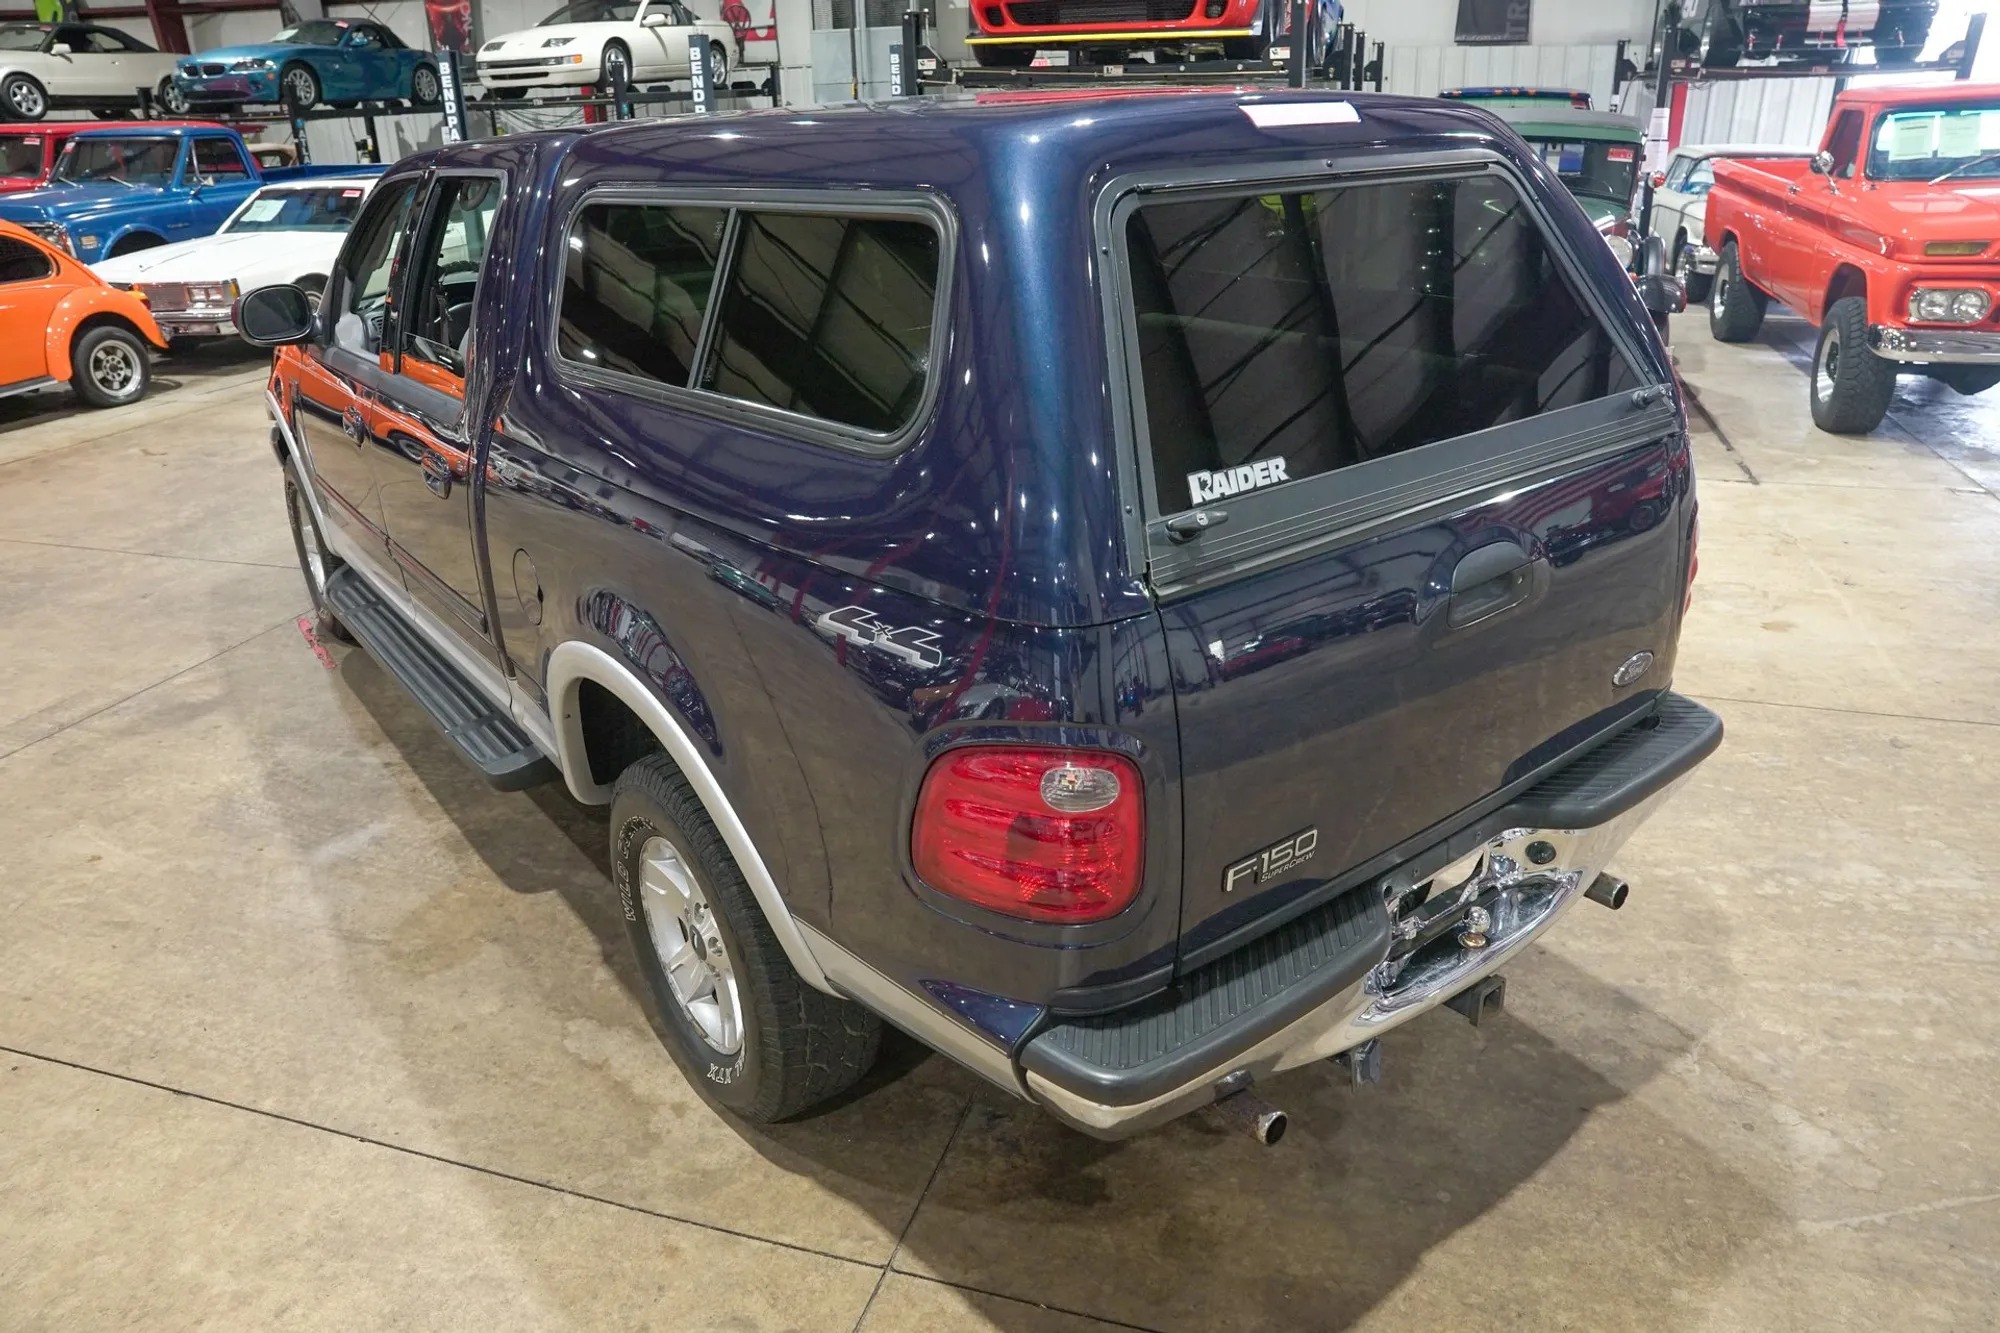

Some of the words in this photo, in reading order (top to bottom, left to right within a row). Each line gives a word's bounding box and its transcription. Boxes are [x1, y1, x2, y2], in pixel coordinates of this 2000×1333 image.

[438, 62, 461, 144] BENDPA
[1187, 456, 1291, 505] RAIDER
[617, 860, 637, 921] WILD
